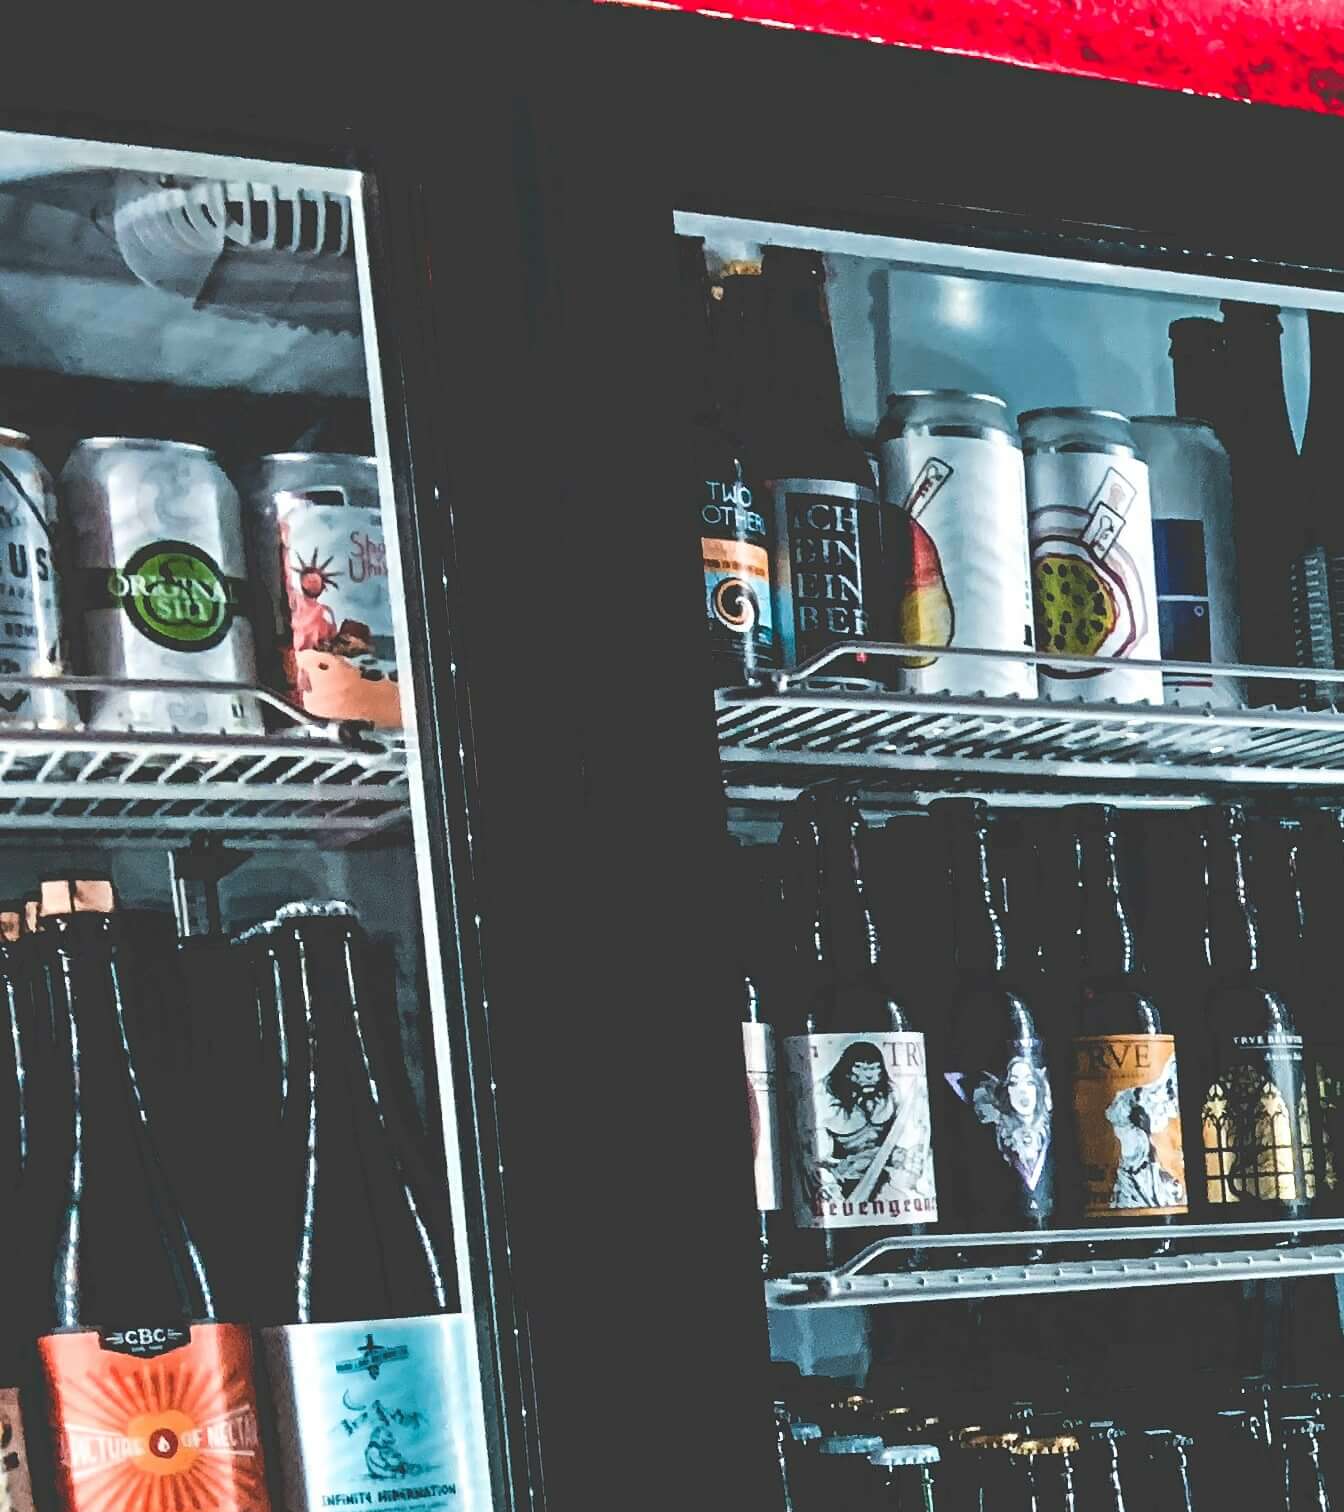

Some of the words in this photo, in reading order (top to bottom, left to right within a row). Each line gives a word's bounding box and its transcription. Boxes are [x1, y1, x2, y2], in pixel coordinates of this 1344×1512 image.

[705, 480, 752, 508] TWO
[797, 573, 863, 602] EIN
[124, 1328, 167, 1346] CBC
